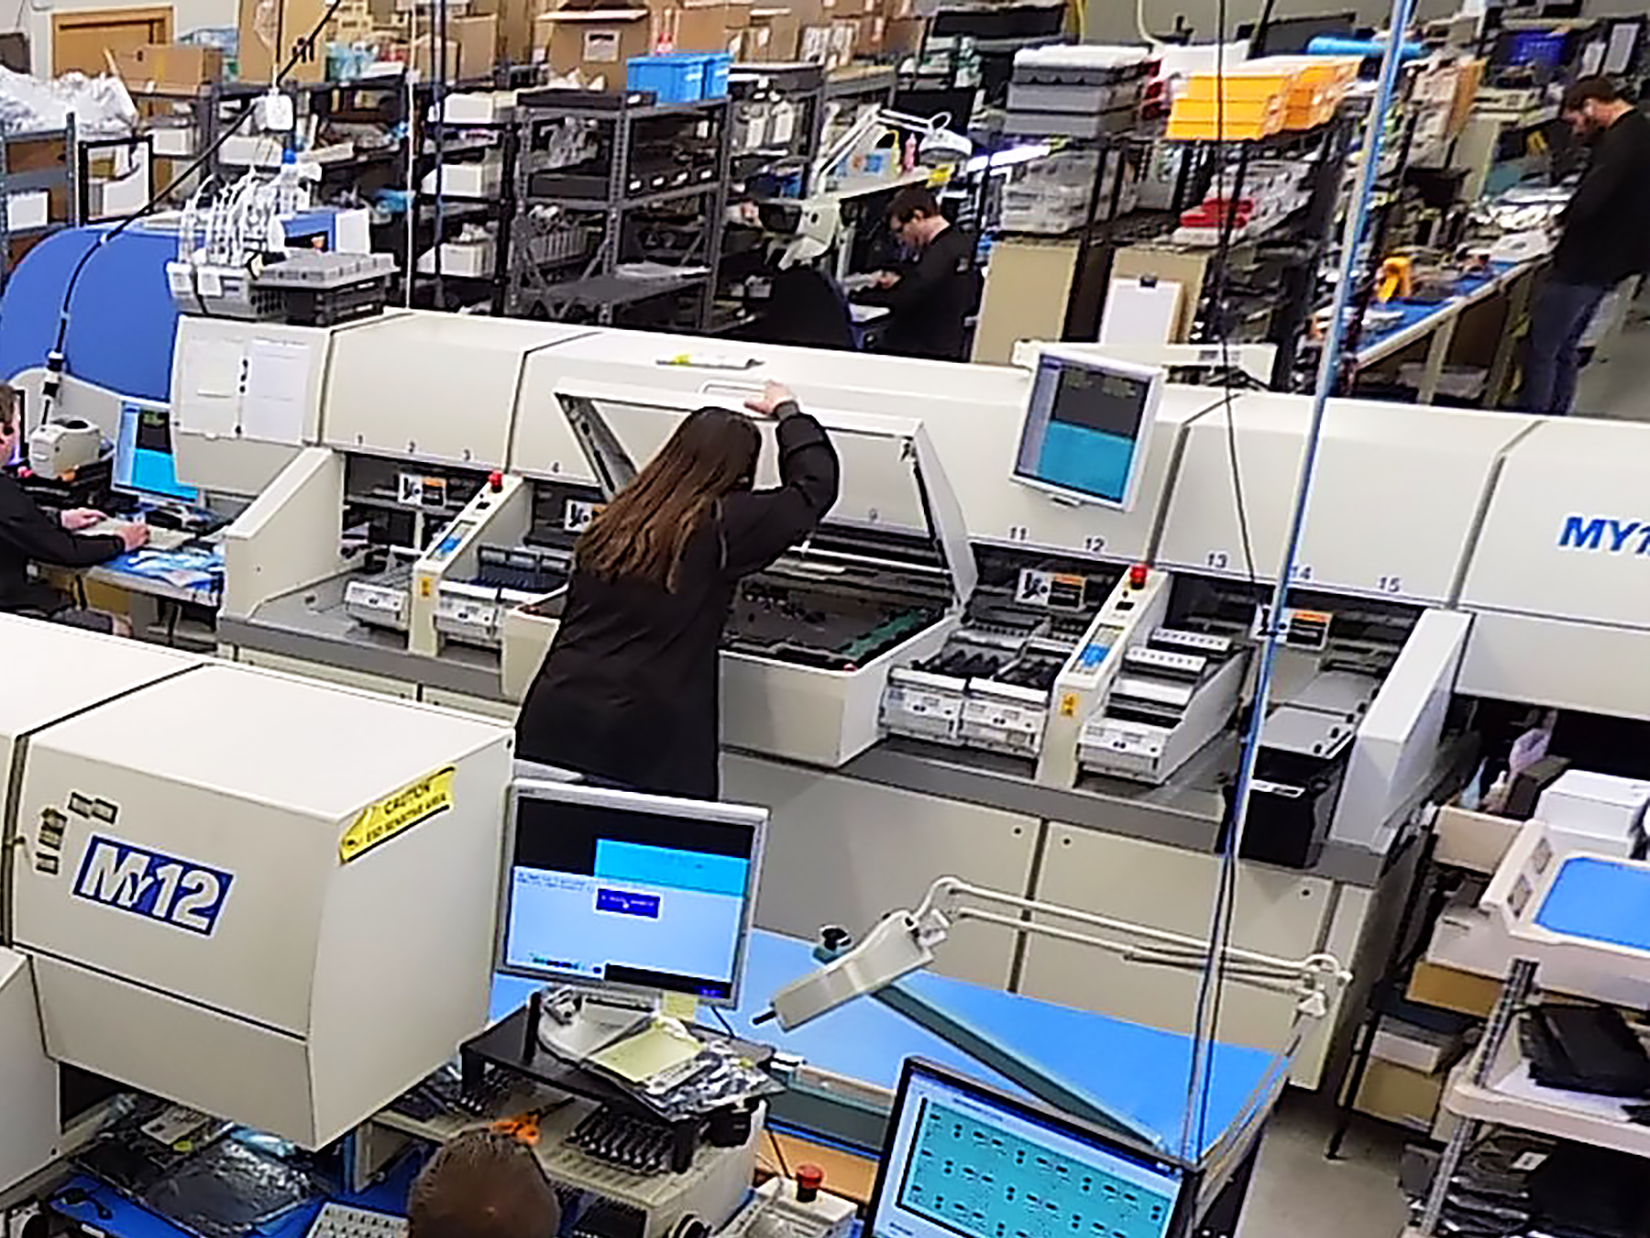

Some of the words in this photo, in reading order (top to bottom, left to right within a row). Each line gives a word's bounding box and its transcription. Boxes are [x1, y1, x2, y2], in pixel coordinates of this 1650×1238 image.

[1009, 526, 1027, 540] 11
[1084, 537, 1105, 552] 12
[1207, 553, 1228, 569] 13
[1378, 576, 1401, 593] 15
